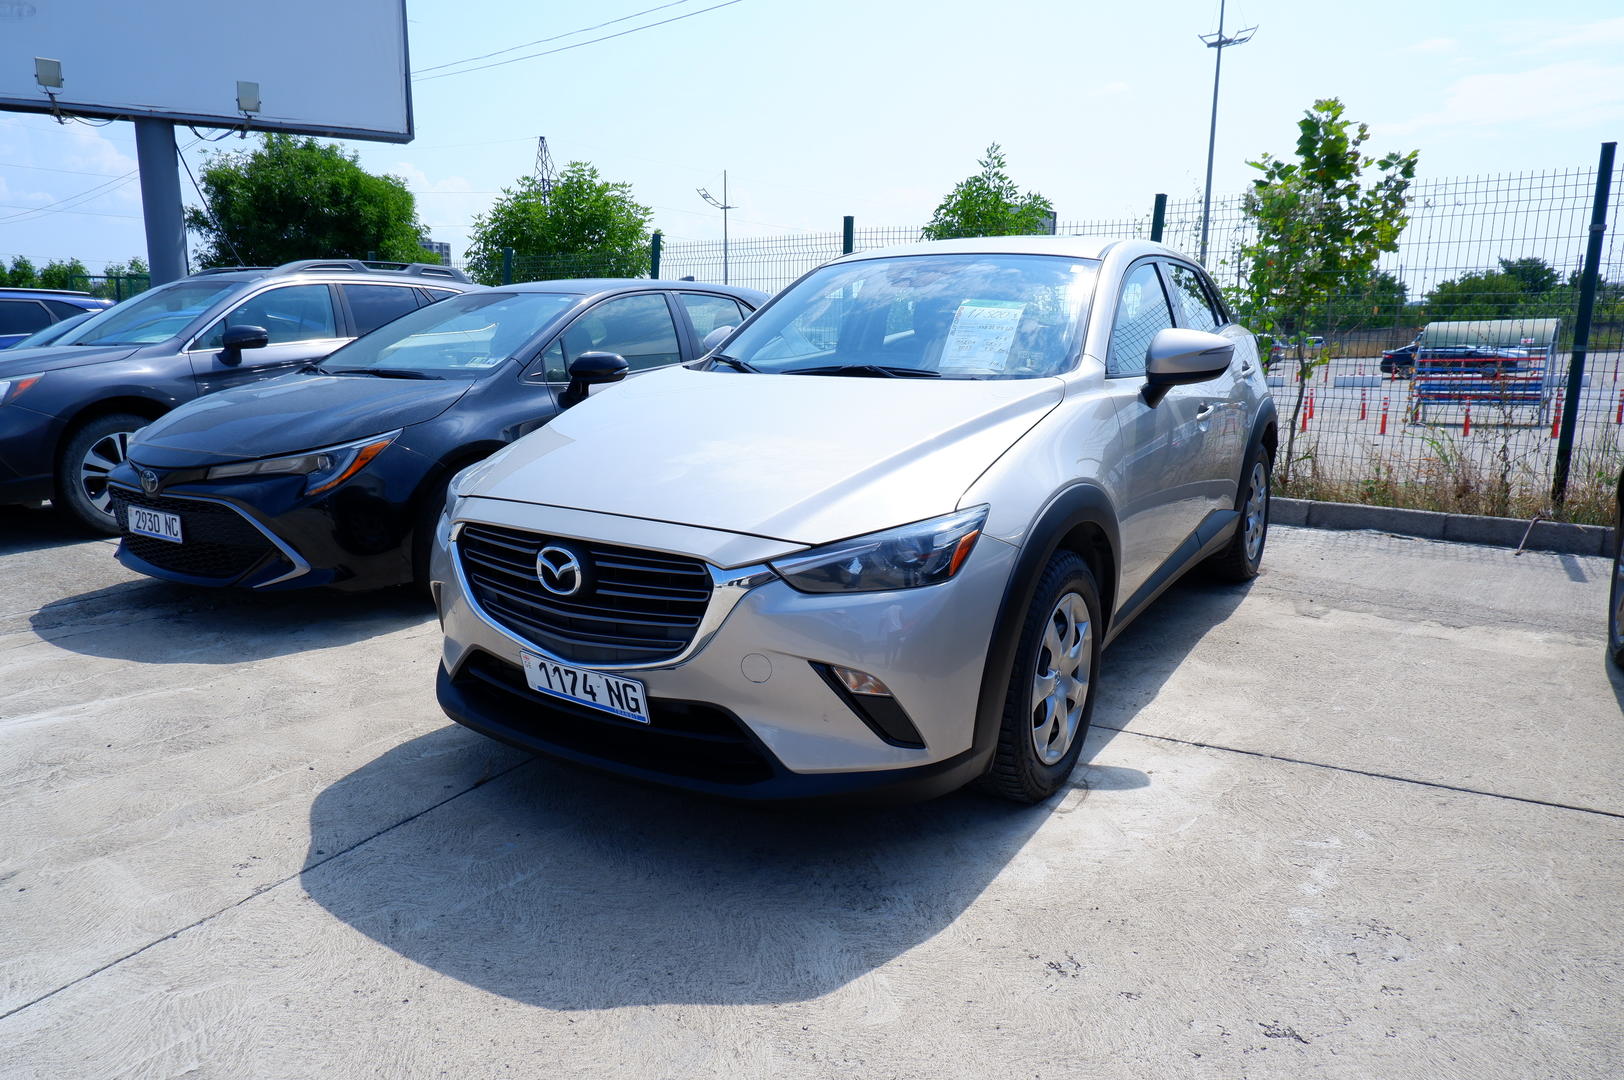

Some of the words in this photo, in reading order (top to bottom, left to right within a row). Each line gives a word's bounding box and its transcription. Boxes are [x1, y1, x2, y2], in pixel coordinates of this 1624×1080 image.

[135, 510, 161, 534] 2930
[164, 514, 179, 537] NC
[538, 661, 597, 702] 1174
[605, 678, 641, 714] NG
